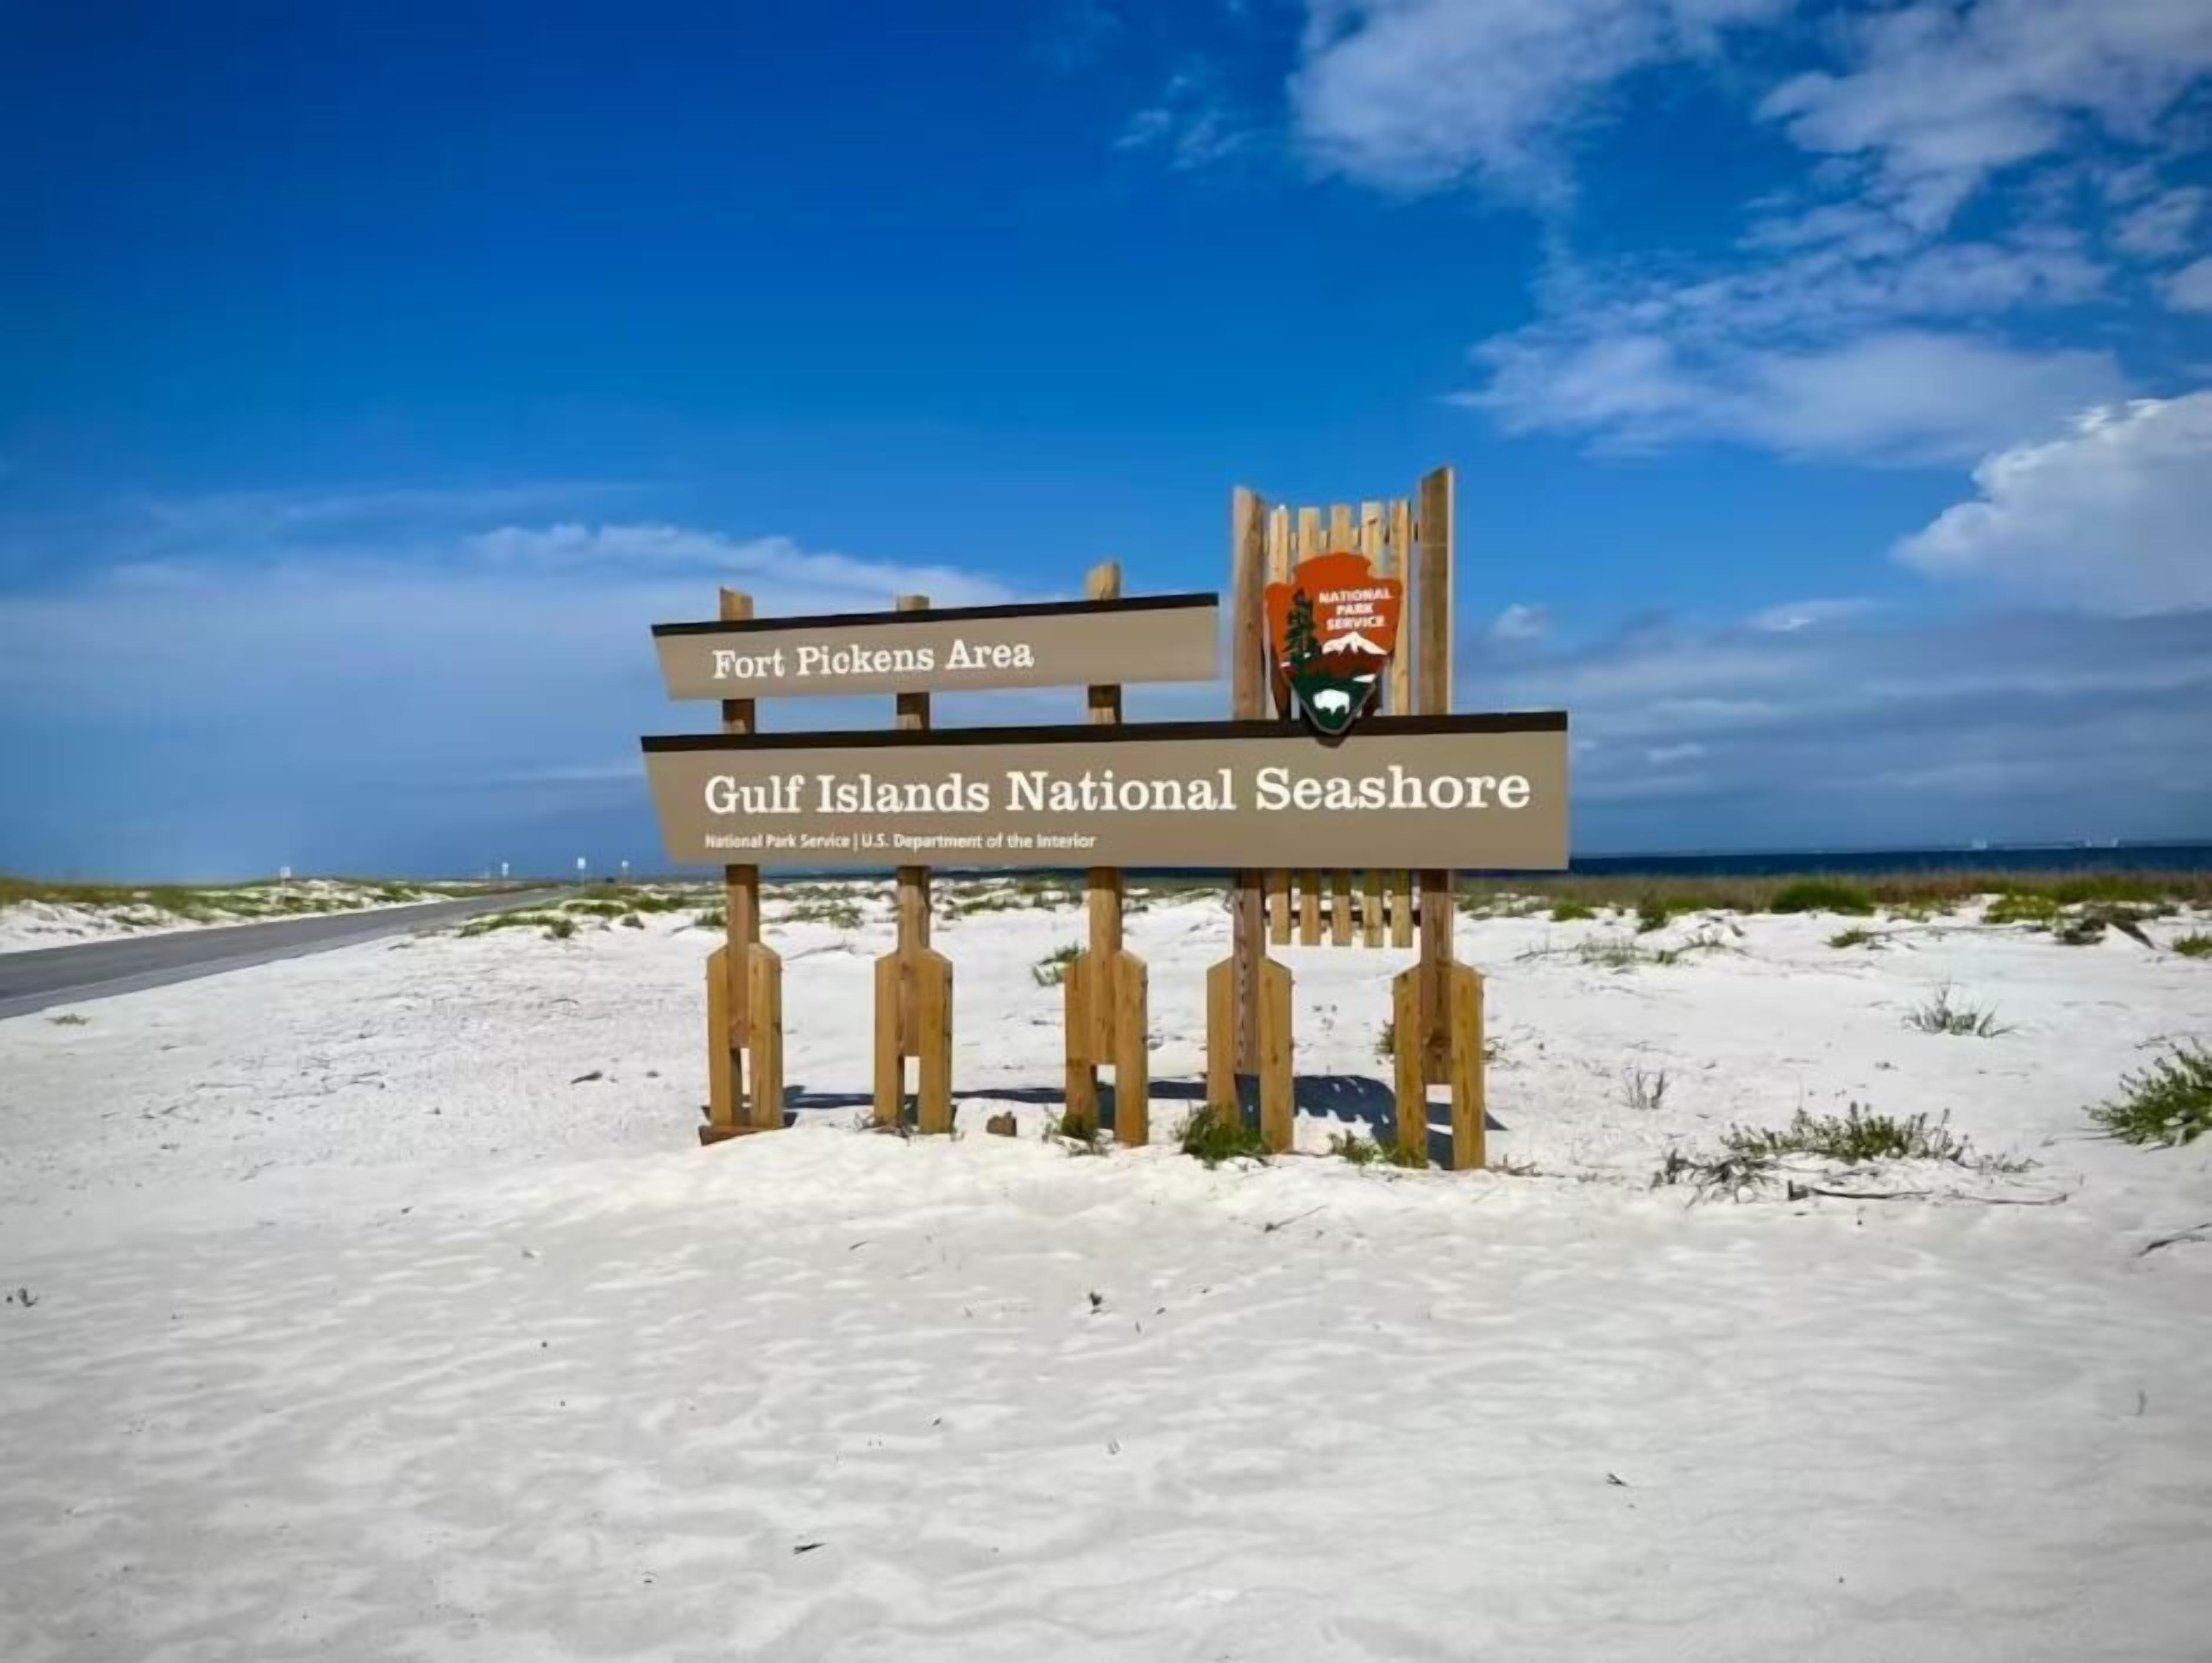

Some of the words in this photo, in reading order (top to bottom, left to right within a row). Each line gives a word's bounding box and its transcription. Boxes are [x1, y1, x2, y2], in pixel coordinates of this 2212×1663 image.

[1319, 588, 1393, 604] NATIONAL
[1336, 602, 1373, 615] PARK
[1326, 615, 1385, 630] SERVICE
[712, 649, 785, 679] Fort
[796, 644, 935, 676] Pickens
[945, 639, 1035, 670] Area
[704, 774, 805, 814] Gulf
[816, 773, 990, 813] Islands
[1005, 768, 1237, 811] National
[1256, 765, 1531, 810] Seashore
[705, 834, 763, 848] National
[766, 833, 796, 848] Park
[800, 833, 851, 848] Service
[862, 833, 889, 848] U.S.
[893, 833, 983, 852] Department
[986, 832, 1004, 848] of
[1006, 833, 1033, 848] the
[1037, 832, 1096, 848] Interior
